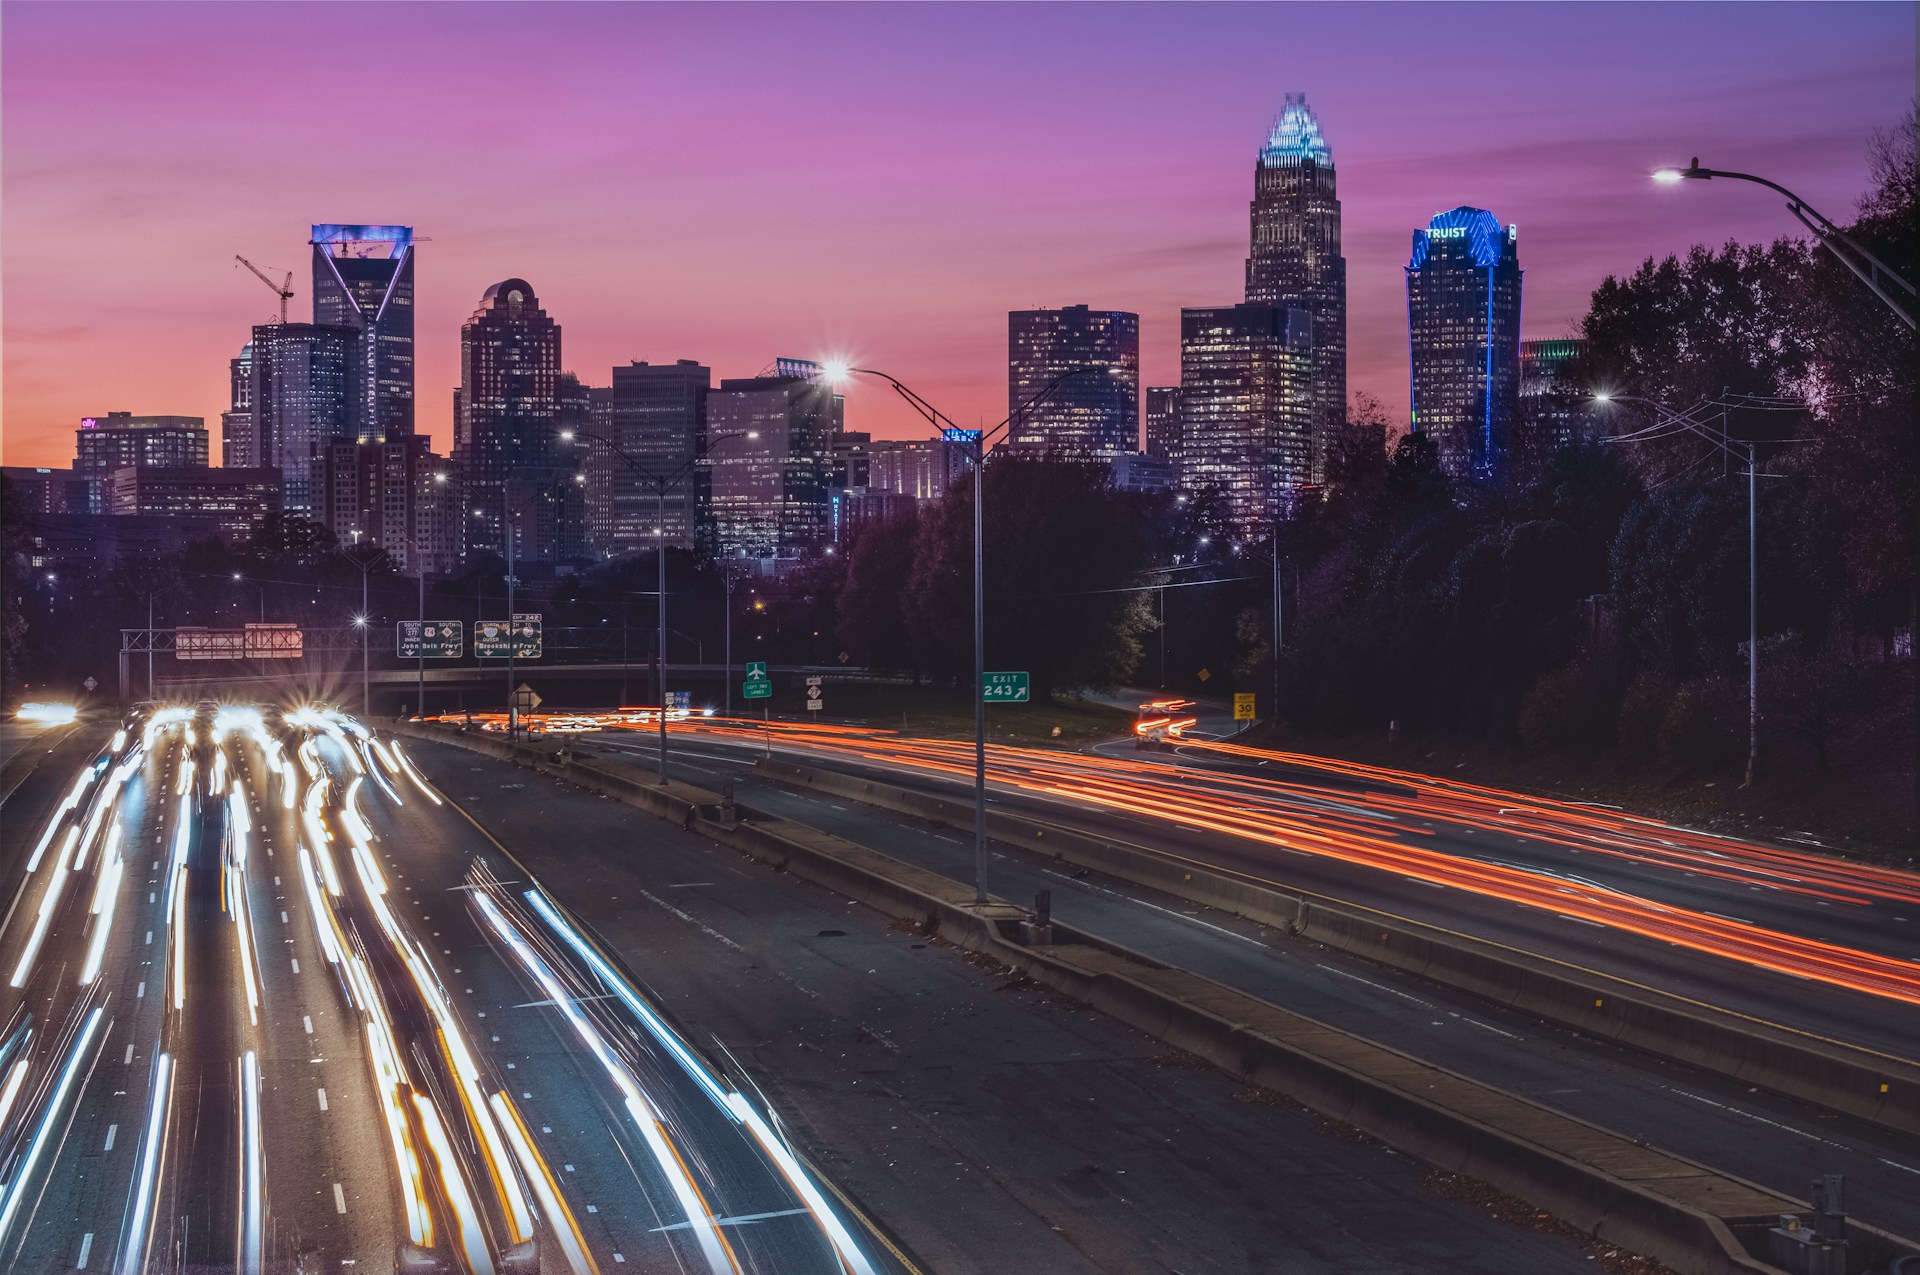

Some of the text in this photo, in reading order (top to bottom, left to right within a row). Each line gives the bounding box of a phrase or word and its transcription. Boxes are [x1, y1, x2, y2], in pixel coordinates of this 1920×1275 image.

[1426, 227, 1467, 239] TRUIST
[82, 418, 96, 429] ally
[519, 642, 537, 650] Frwy
[992, 675, 1018, 683] EXIT
[810, 688, 819, 696] 27
[984, 685, 1013, 696] 243
[1239, 704, 1252, 713] 30
